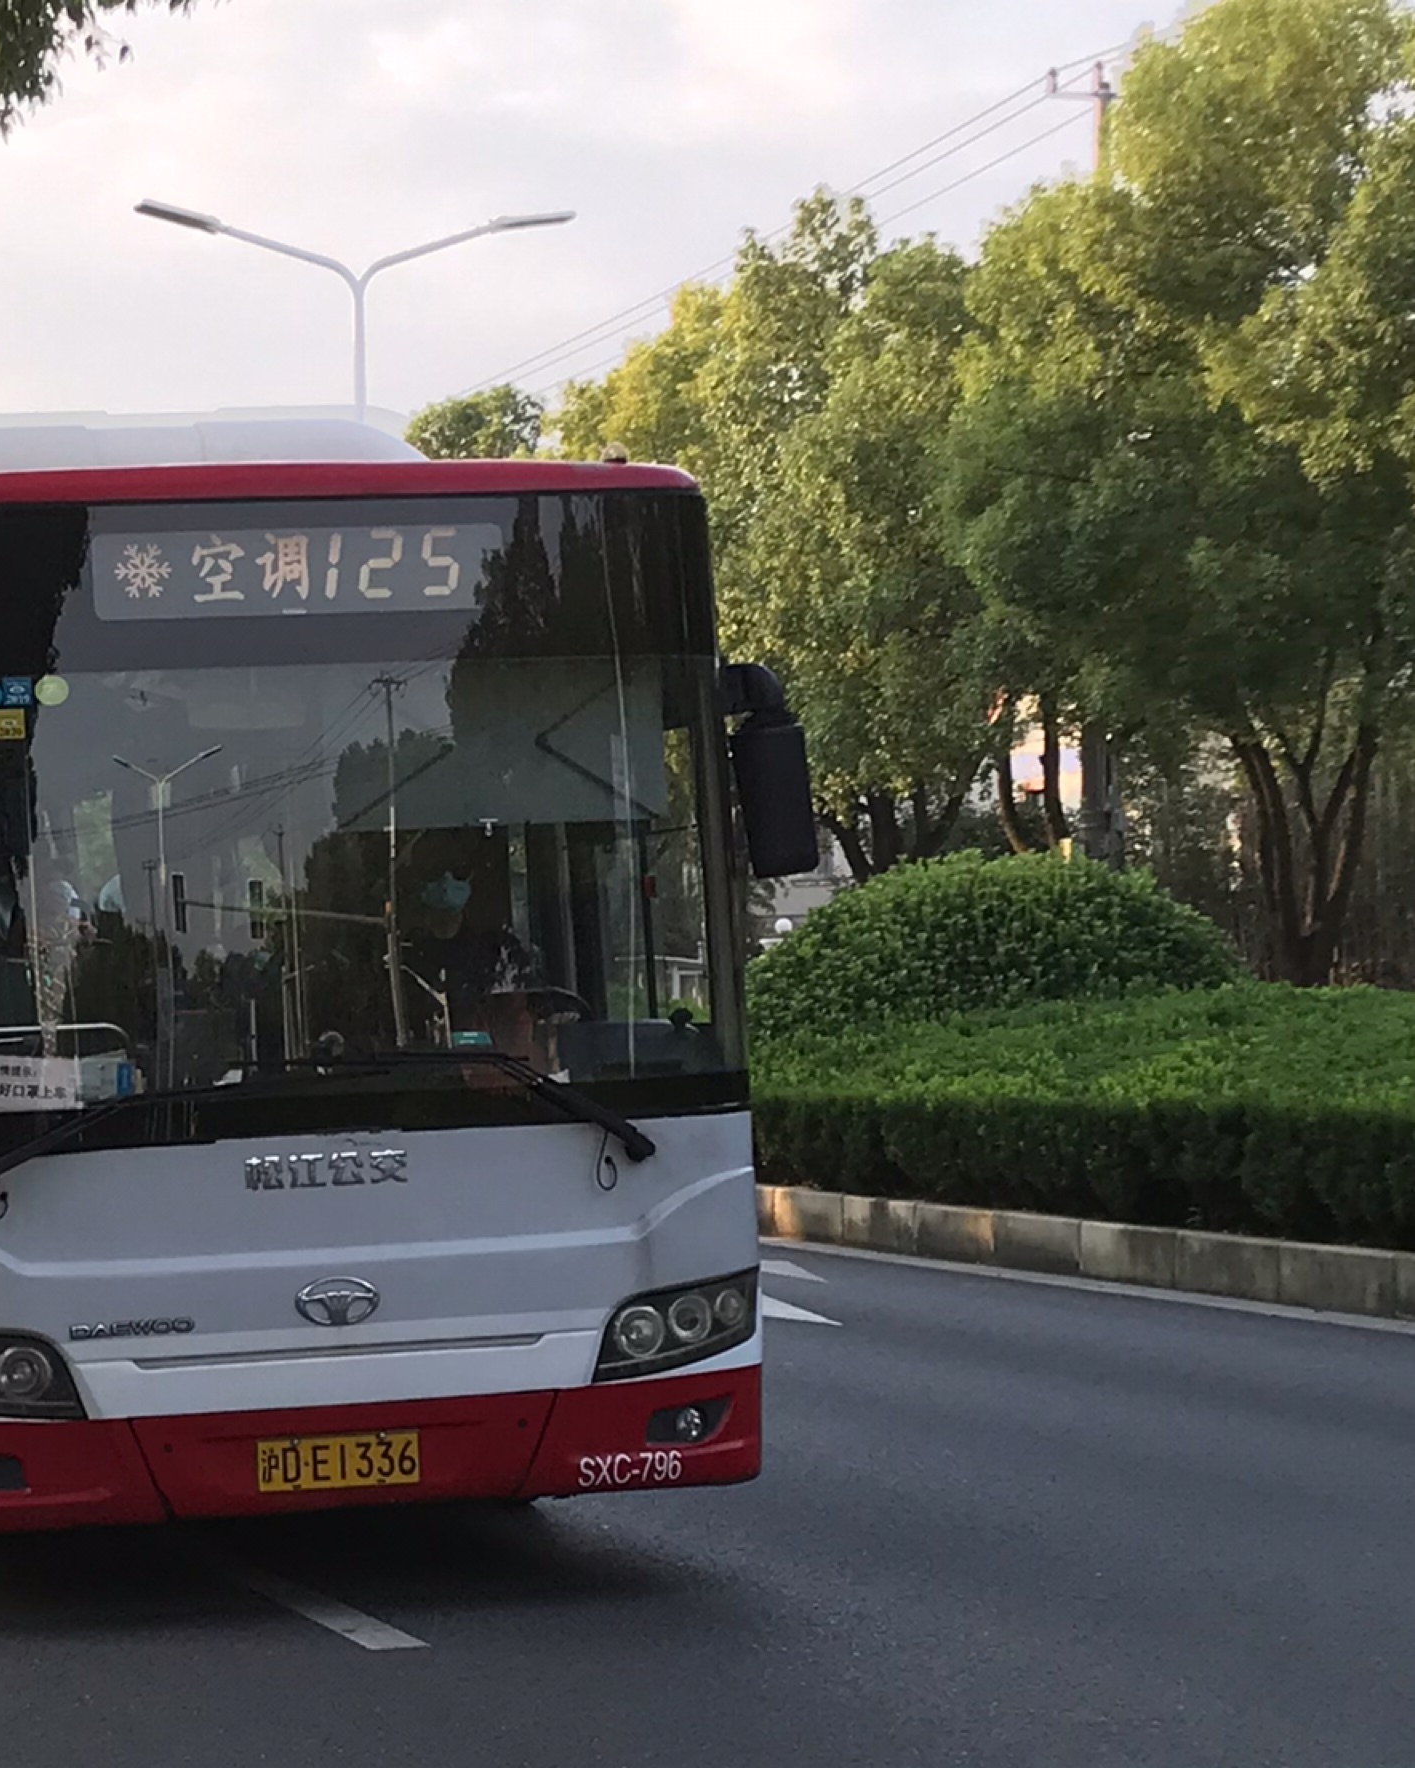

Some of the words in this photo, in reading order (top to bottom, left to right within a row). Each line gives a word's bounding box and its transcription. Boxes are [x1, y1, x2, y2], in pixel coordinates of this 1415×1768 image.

[245, 1149, 408, 1191] 松江公交
[69, 1316, 195, 1341] DAEWOO
[578, 1450, 682, 1487] SXC-796
